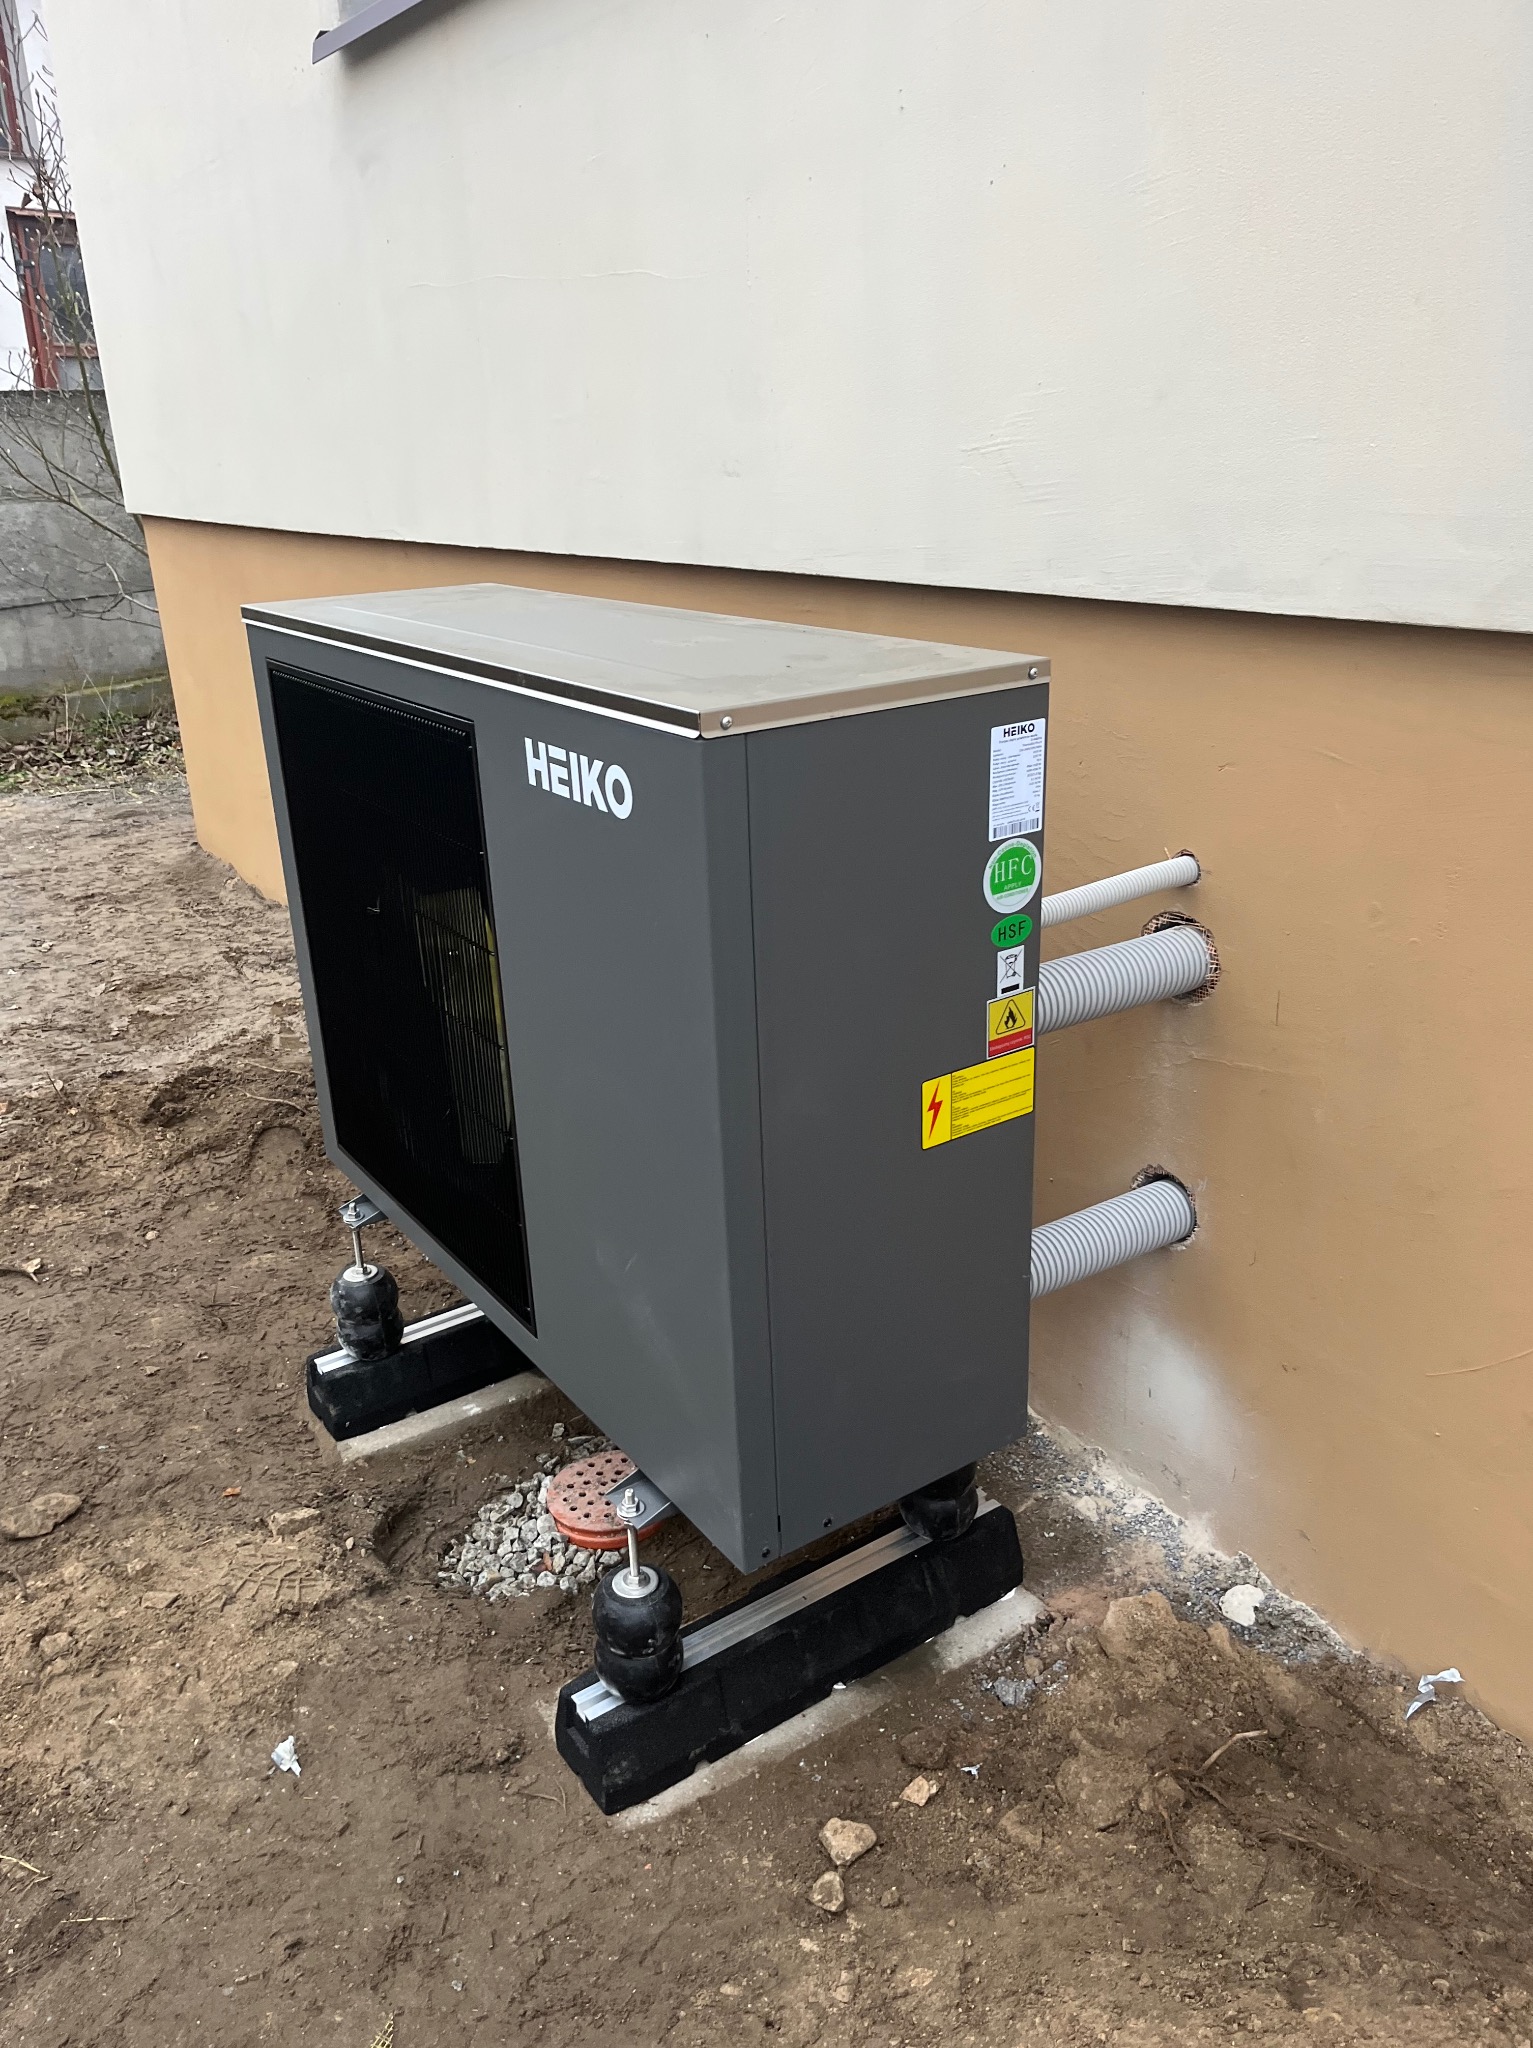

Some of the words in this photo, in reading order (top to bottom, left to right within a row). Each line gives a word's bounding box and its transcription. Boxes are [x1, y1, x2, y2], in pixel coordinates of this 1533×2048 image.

[1003, 723, 1035, 737] HEIKO
[524, 737, 633, 820] HEIKO
[994, 854, 1032, 884] HFC
[1003, 880, 1022, 891] APPLY
[998, 919, 1026, 942] HSF
